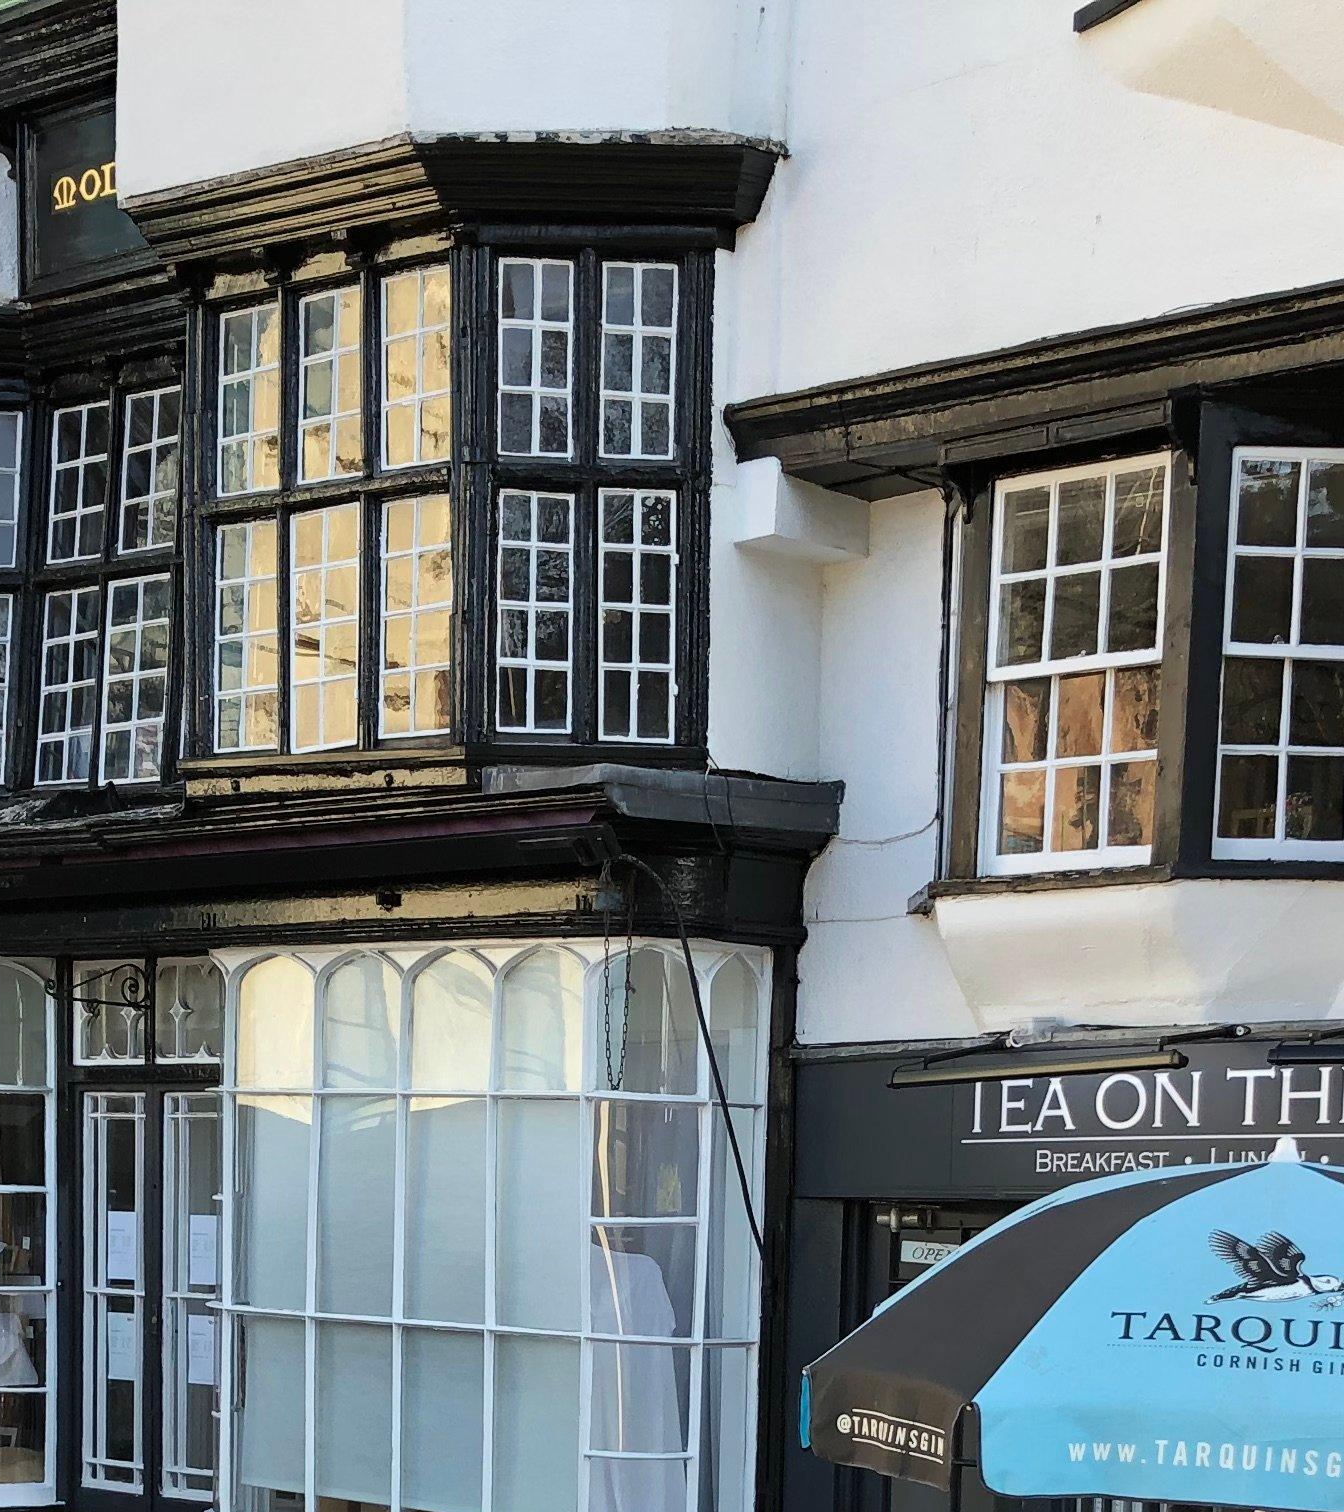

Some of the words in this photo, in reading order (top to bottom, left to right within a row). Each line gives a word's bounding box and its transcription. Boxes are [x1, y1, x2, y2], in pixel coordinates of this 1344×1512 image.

[1094, 1071, 1203, 1130] ON
[1035, 1149, 1170, 1173] BREAKFAST
[1196, 1353, 1300, 1373] CORNISH
